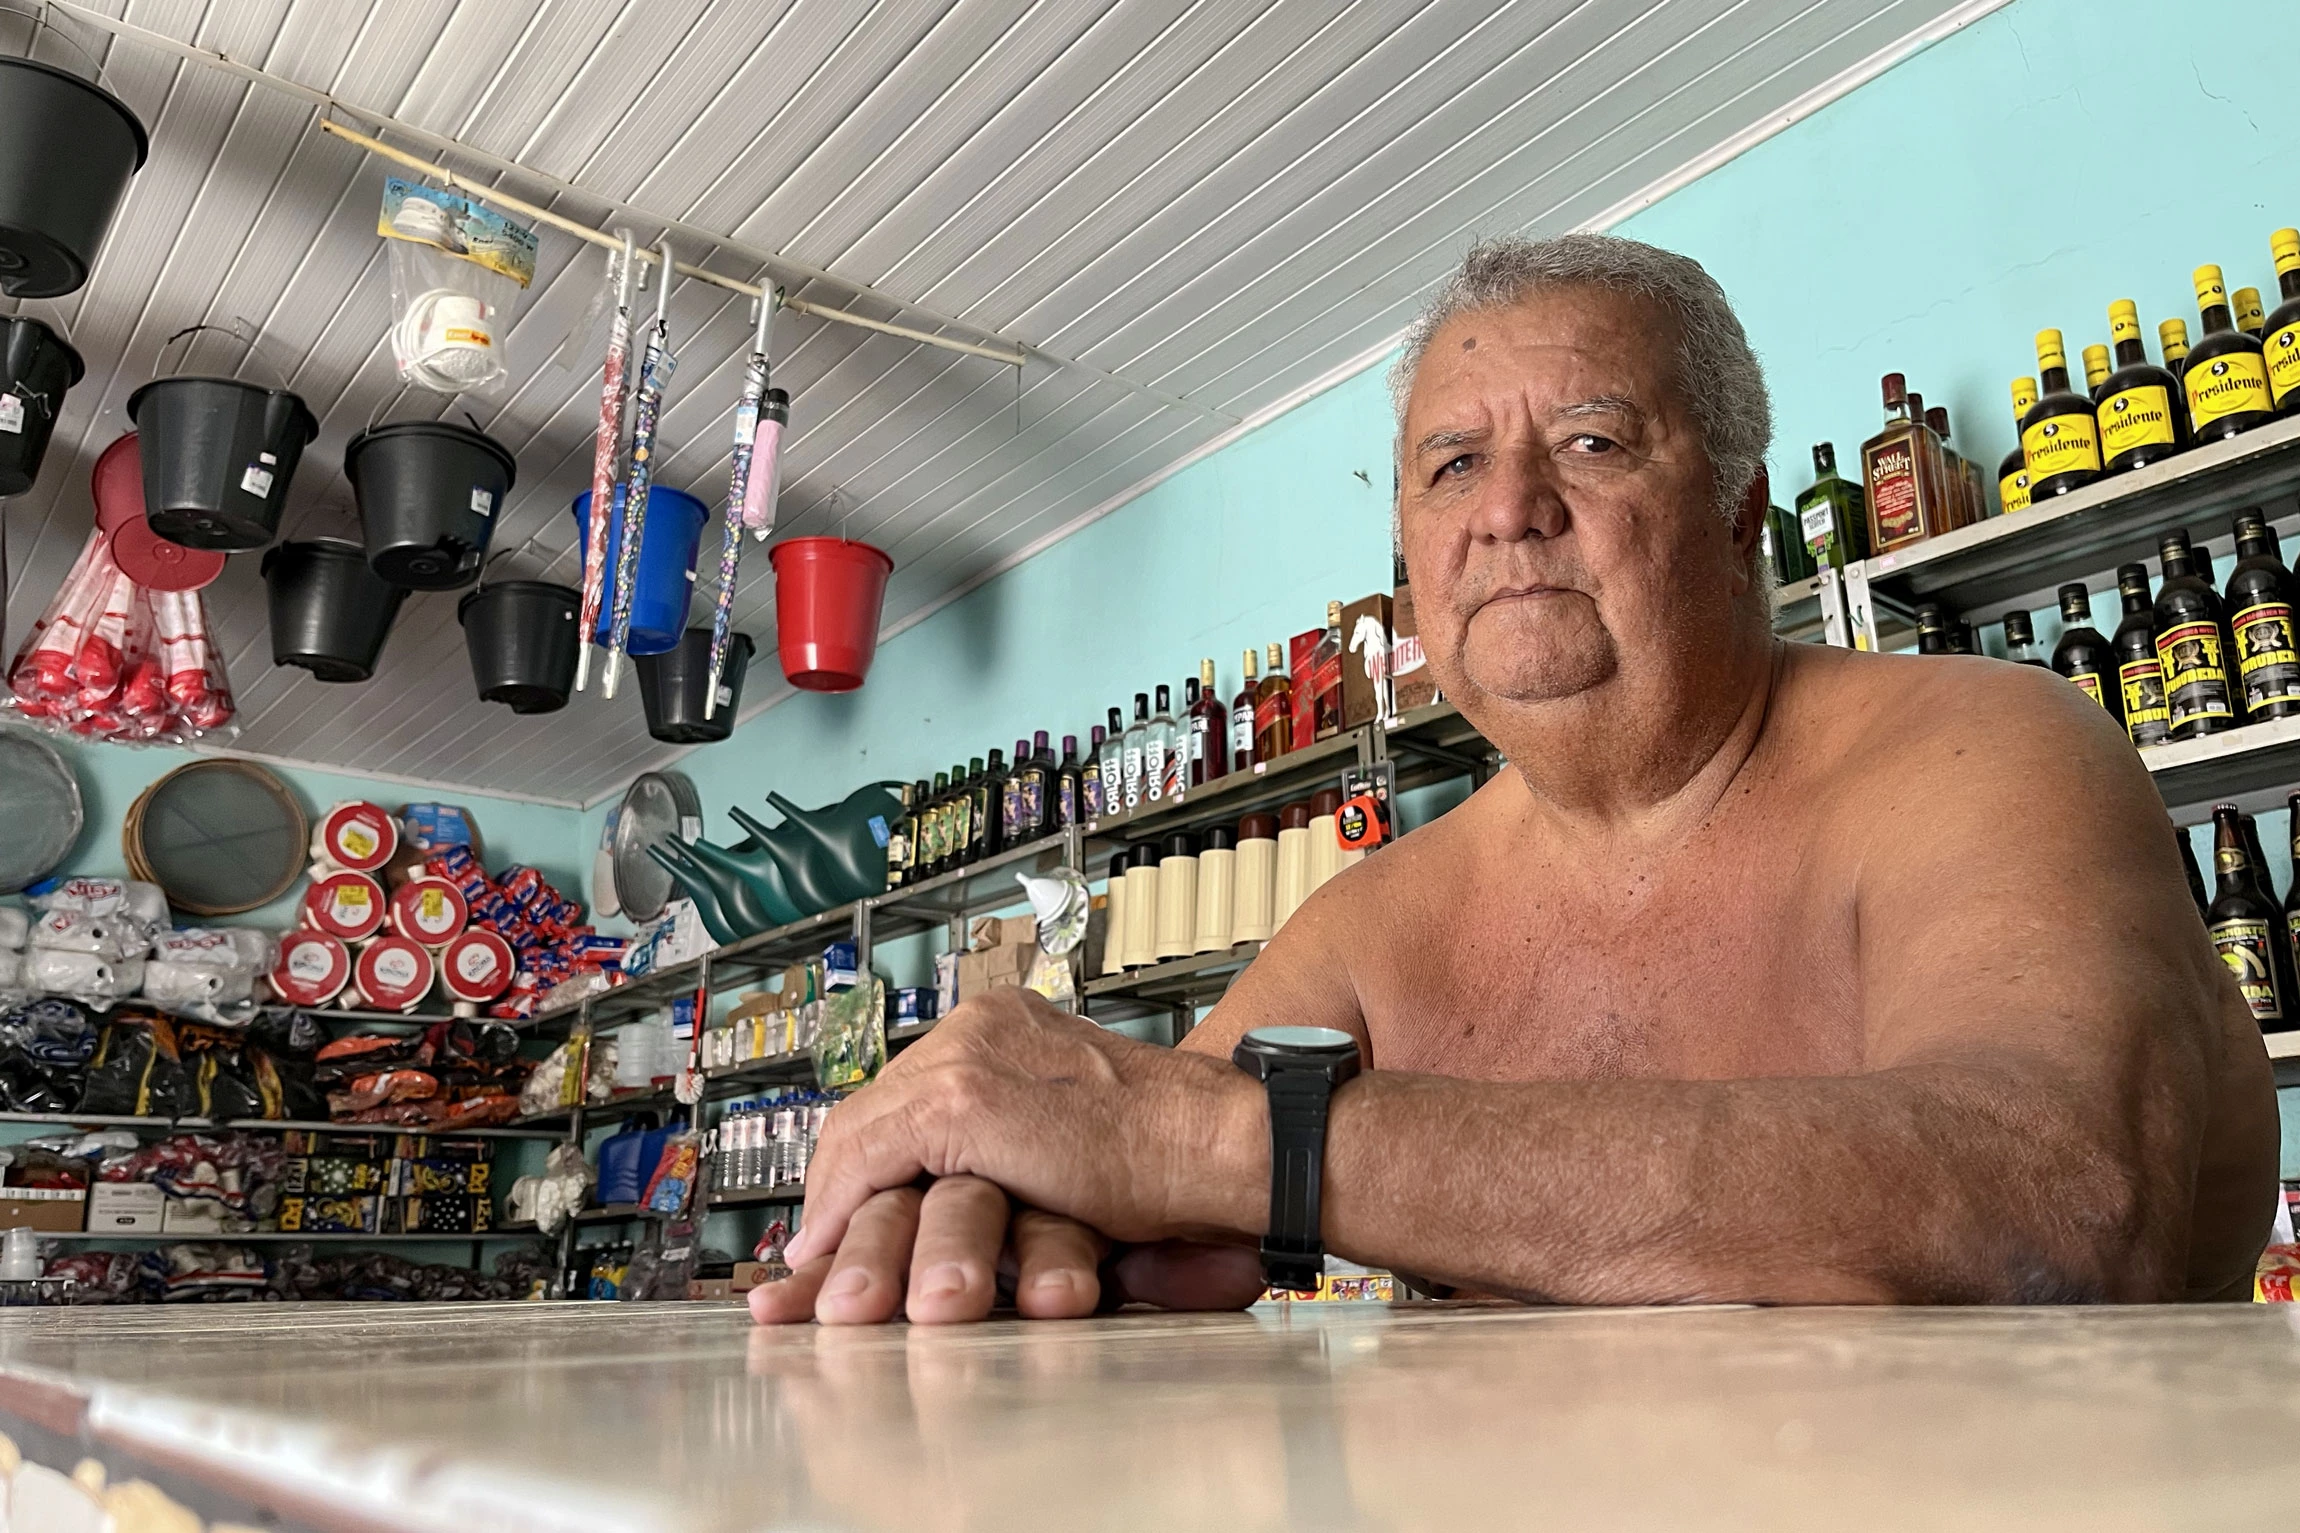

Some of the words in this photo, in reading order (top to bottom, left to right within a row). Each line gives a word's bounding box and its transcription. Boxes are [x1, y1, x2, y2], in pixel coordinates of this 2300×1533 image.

[2191, 376, 2263, 407] Presidente
[2100, 409, 2163, 439] Presidente
[2026, 436, 2091, 465] Presidente
[1803, 507, 1829, 526] PASSPORT
[2166, 667, 2225, 695] JURUBEBA
[1125, 750, 1139, 808] ORLOFF
[1147, 742, 1162, 801] ORLOFF
[1104, 759, 1120, 815] ORLOFF
